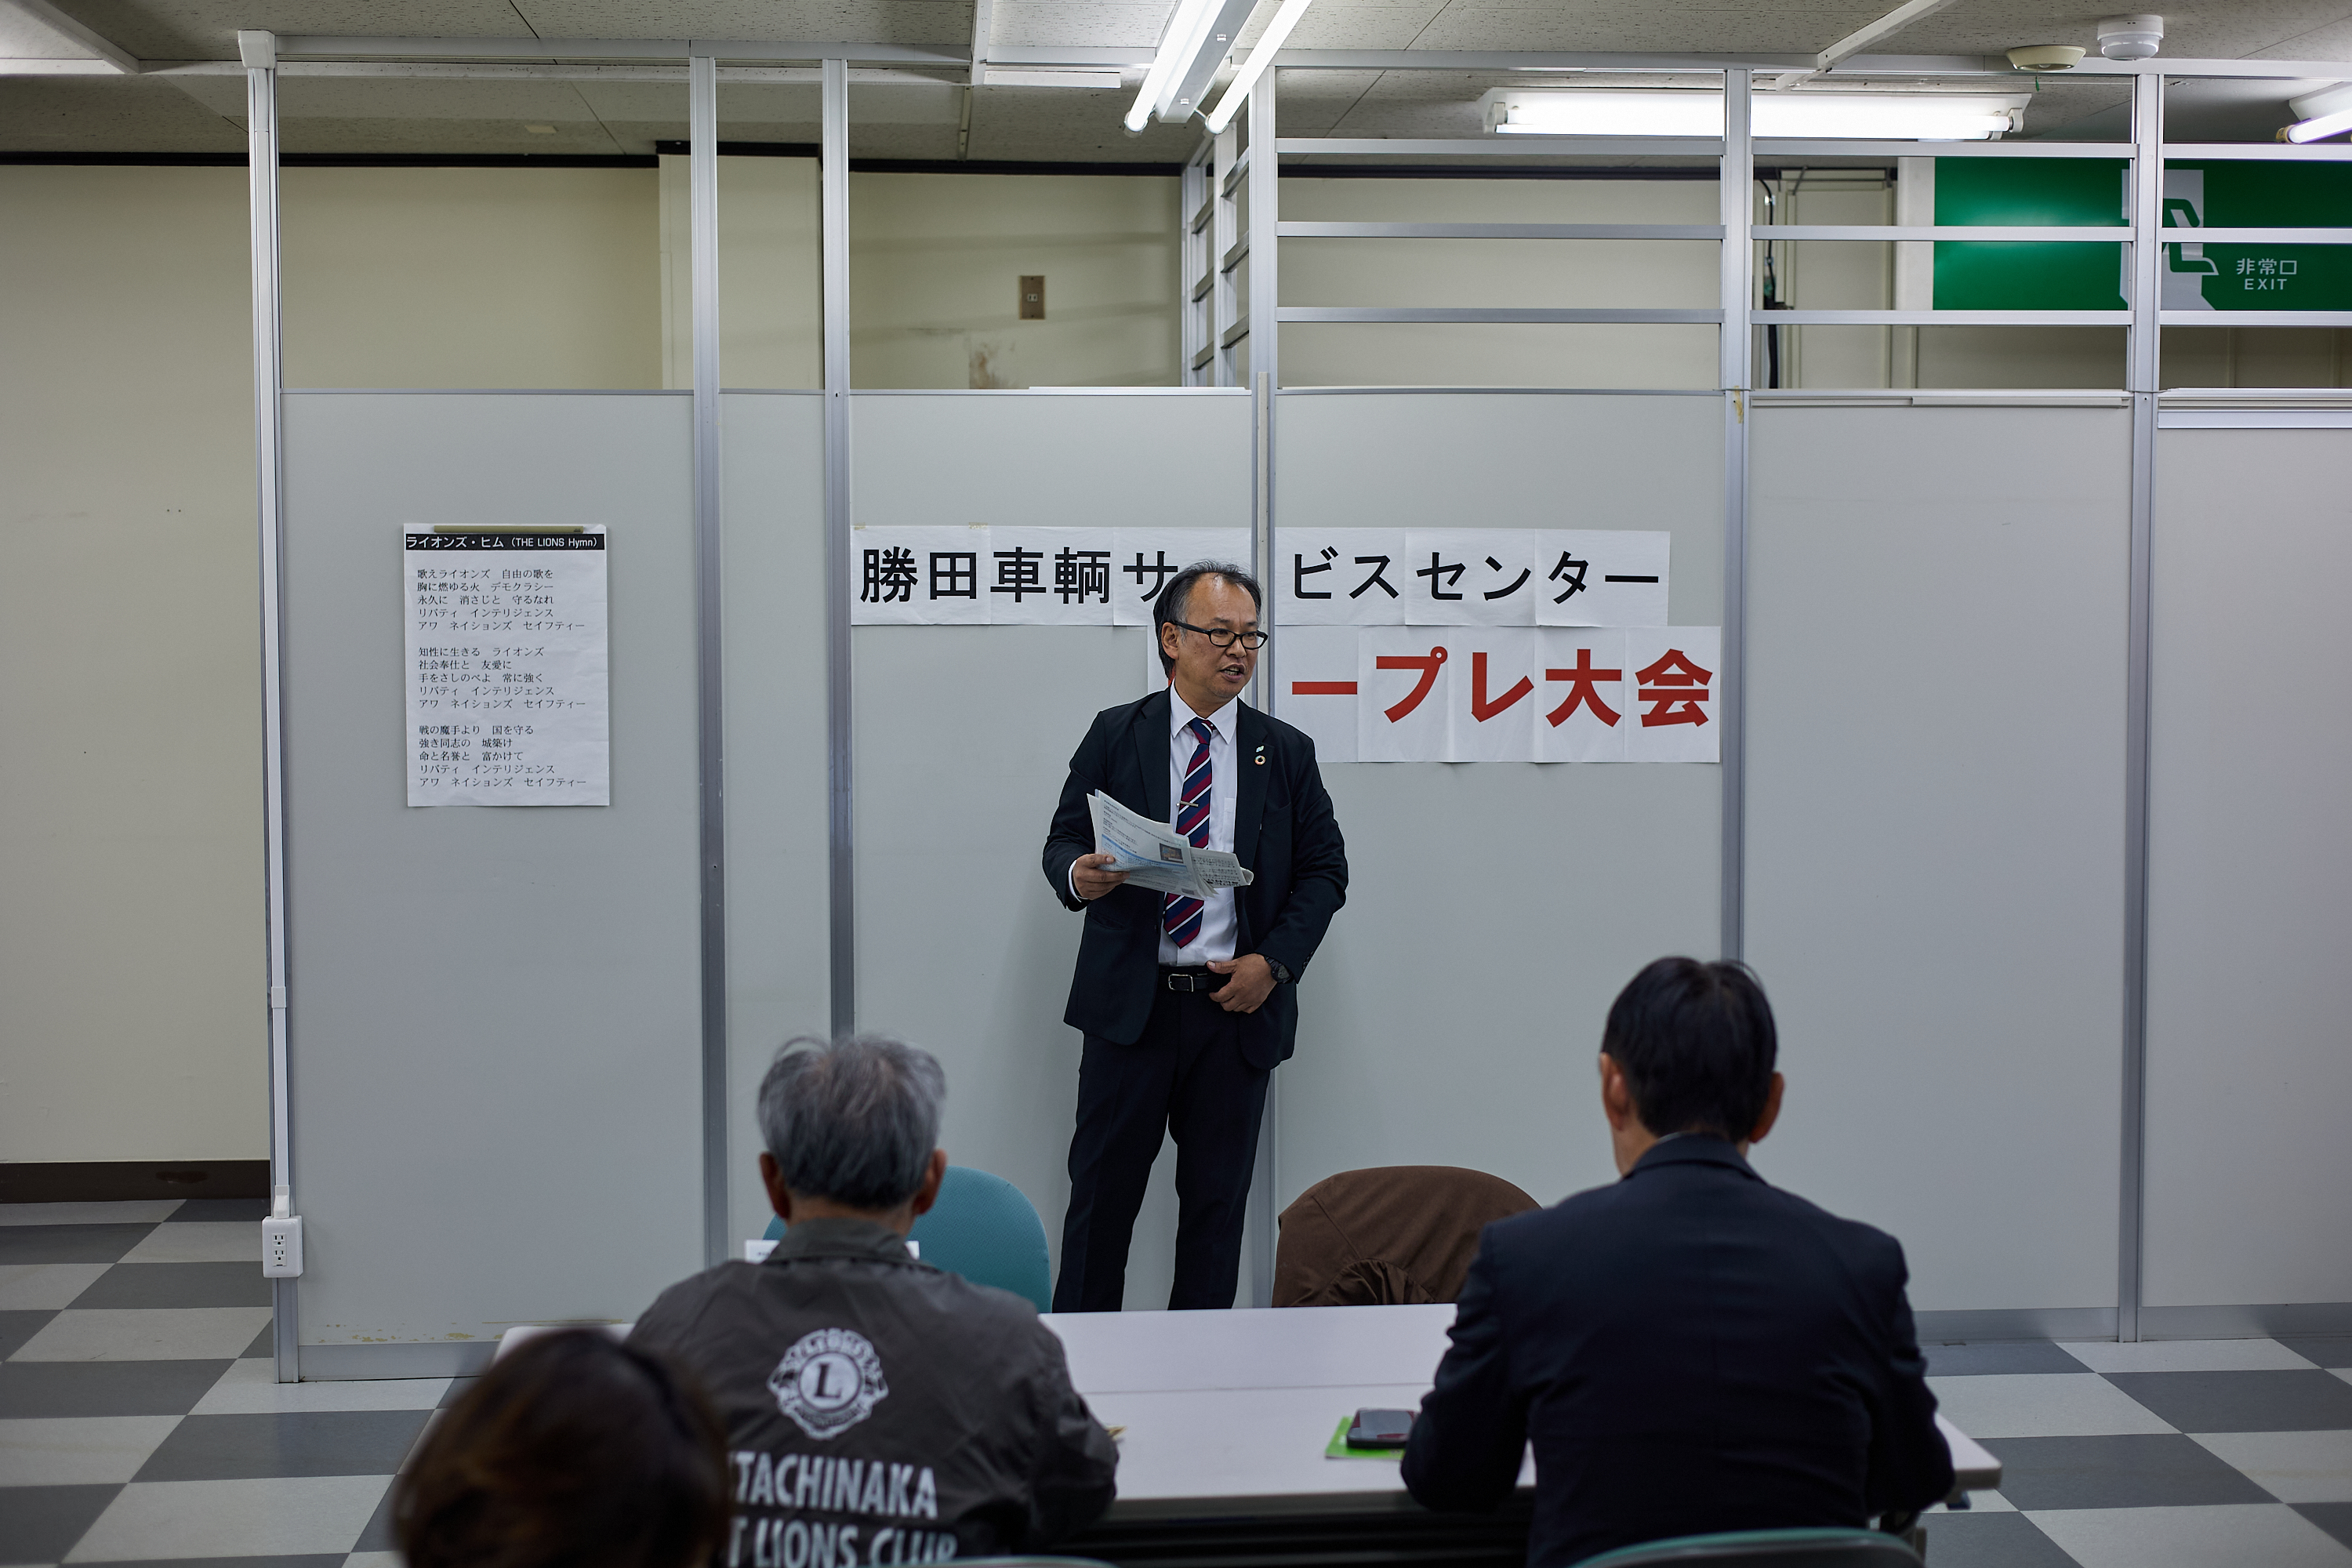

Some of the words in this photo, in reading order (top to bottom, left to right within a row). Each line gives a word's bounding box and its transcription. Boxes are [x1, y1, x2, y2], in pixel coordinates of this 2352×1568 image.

[2236, 258, 2297, 274] 非常口
[2244, 278, 2287, 290] EXIT
[406, 536, 504, 548] ライオンズ・ヒム
[538, 538, 564, 546] LIONS
[417, 568, 491, 579] 歌えライオンズ
[502, 568, 554, 579] 自由の歌を
[860, 546, 1659, 604] 勝田車輌サビスセンター
[417, 582, 480, 592] 胸に燃ゆる火
[491, 581, 554, 593] デモクラシー
[417, 594, 448, 605] 永久に
[459, 594, 500, 605] 消さじと
[512, 594, 554, 605] 守るなれ
[470, 608, 554, 619] インテリジェンス
[419, 621, 437, 630] アワ
[450, 620, 513, 631] ネイションズ
[523, 621, 585, 631] セイフティー
[419, 647, 481, 657] 知性に生きる
[492, 646, 545, 657] ライオンズ
[419, 659, 470, 670] 社会奉仕と
[481, 659, 512, 670] 友愛に
[419, 673, 491, 684] 手をさしのべよ
[502, 673, 543, 683] 常に強く
[471, 686, 554, 696] インテリジェンス
[1168, 646, 1712, 728] ープレ大会
[419, 699, 438, 709] アワ
[451, 699, 513, 710] ネイションズ
[524, 699, 586, 709] セイフティー
[419, 724, 480, 735] 戦の魔手より
[492, 724, 534, 735] 国を守る
[419, 738, 470, 749] 強き同志の
[481, 738, 513, 749] 城築け
[419, 750, 470, 761] 命と名誉と
[481, 751, 523, 762] 富かけて
[472, 764, 555, 775] インテリジェンス
[419, 778, 439, 787] アワ
[452, 777, 514, 787] ネイションズ
[524, 778, 586, 787] セイフティー
[814, 1361, 842, 1399] L
[728, 1450, 938, 1519] TACHINAKA
[753, 1518, 859, 1568] LIONS
